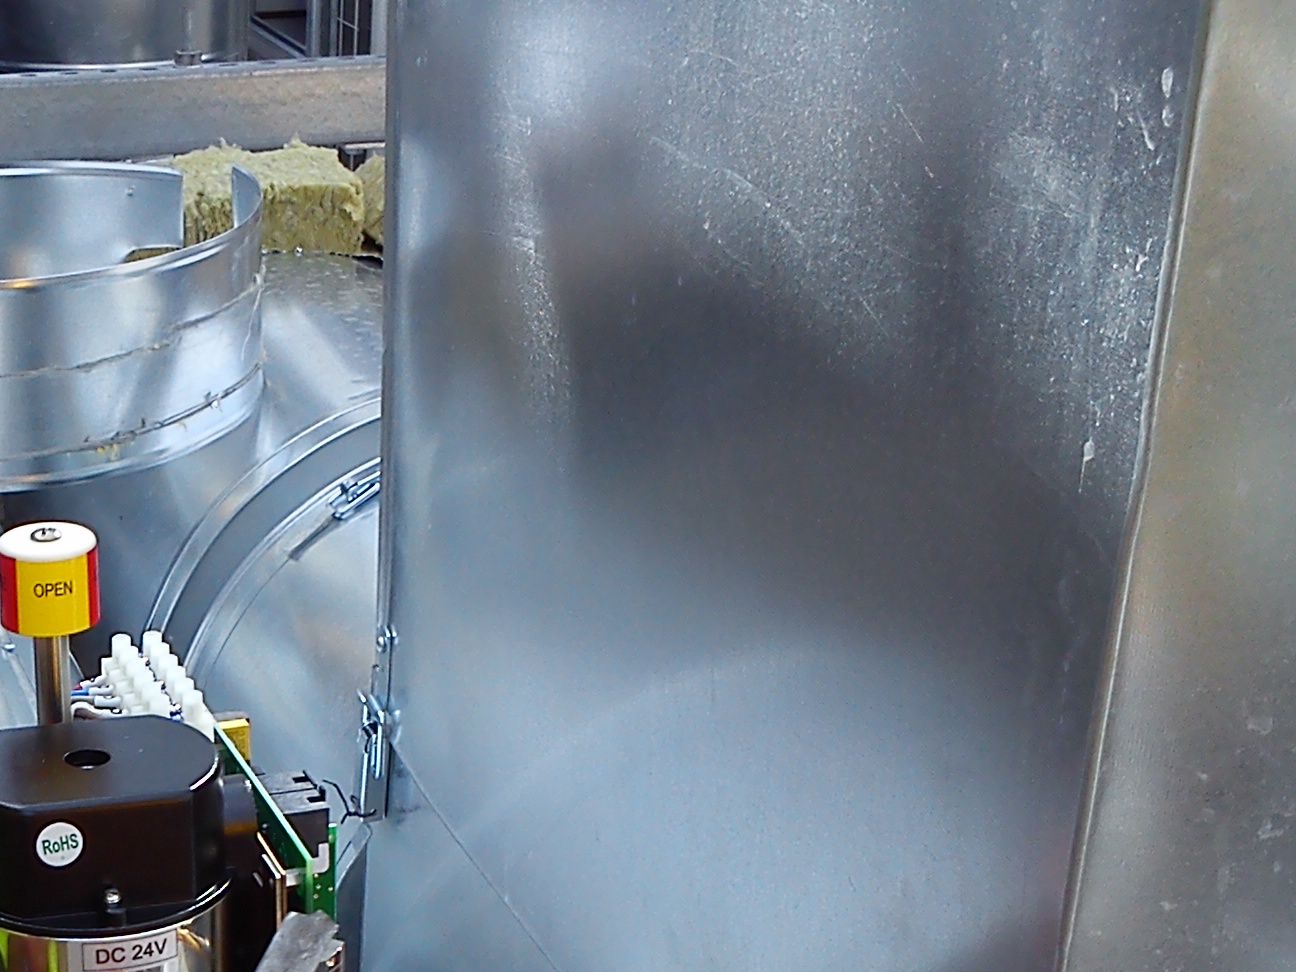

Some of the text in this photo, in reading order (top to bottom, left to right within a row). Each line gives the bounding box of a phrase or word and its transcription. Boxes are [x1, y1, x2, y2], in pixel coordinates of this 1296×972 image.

[33, 580, 73, 598] OPEN
[42, 833, 79, 855] RoHS
[96, 938, 168, 965] DC 24V
